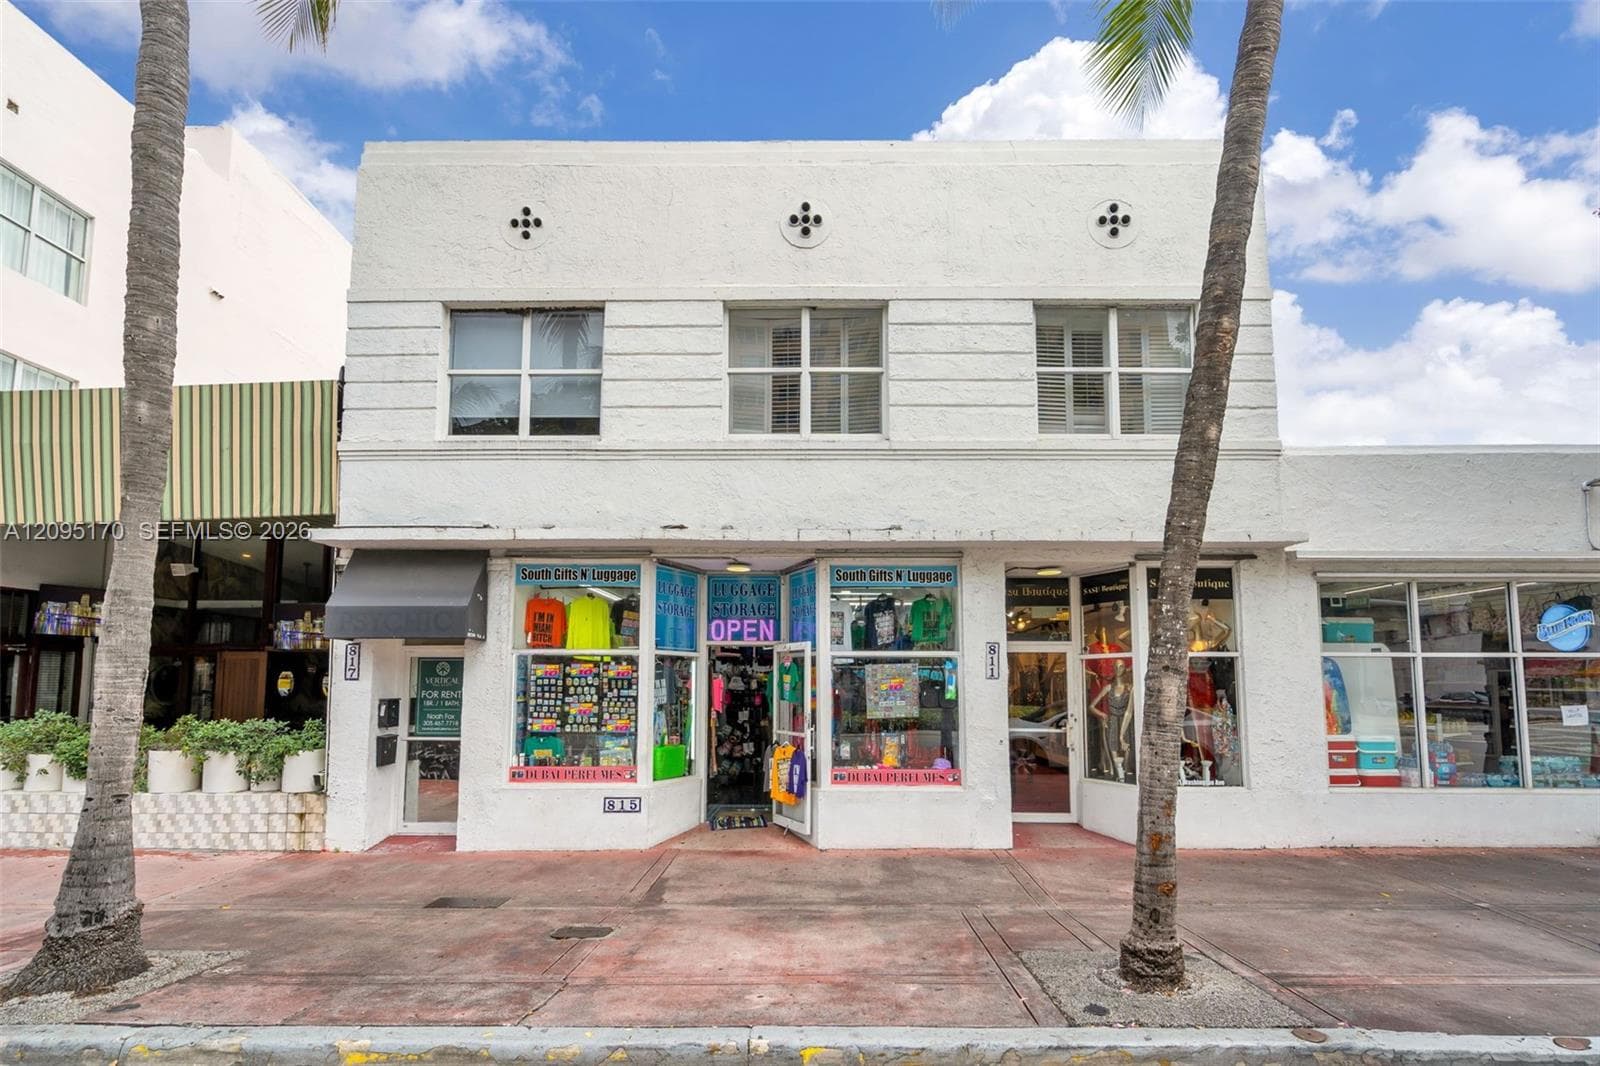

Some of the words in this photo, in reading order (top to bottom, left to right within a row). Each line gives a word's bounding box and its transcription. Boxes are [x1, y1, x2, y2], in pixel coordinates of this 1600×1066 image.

[521, 568, 551, 580] South
[554, 568, 578, 580] Gifts
[592, 568, 637, 582] Luggage
[835, 569, 866, 582] South
[869, 569, 893, 582] Gifts
[907, 570, 953, 583] Luggage
[657, 580, 695, 598] LUGGAGE
[713, 583, 776, 597] LUGGAGE
[1196, 578, 1231, 590] utique
[657, 602, 695, 617] STORAGE
[713, 603, 776, 616] STORAGE
[710, 619, 775, 641] OPEN
[347, 646, 357, 678] 817
[988, 645, 997, 677] 811
[421, 690, 439, 699] FOR
[440, 690, 462, 699] RENT
[607, 800, 638, 810] 815
